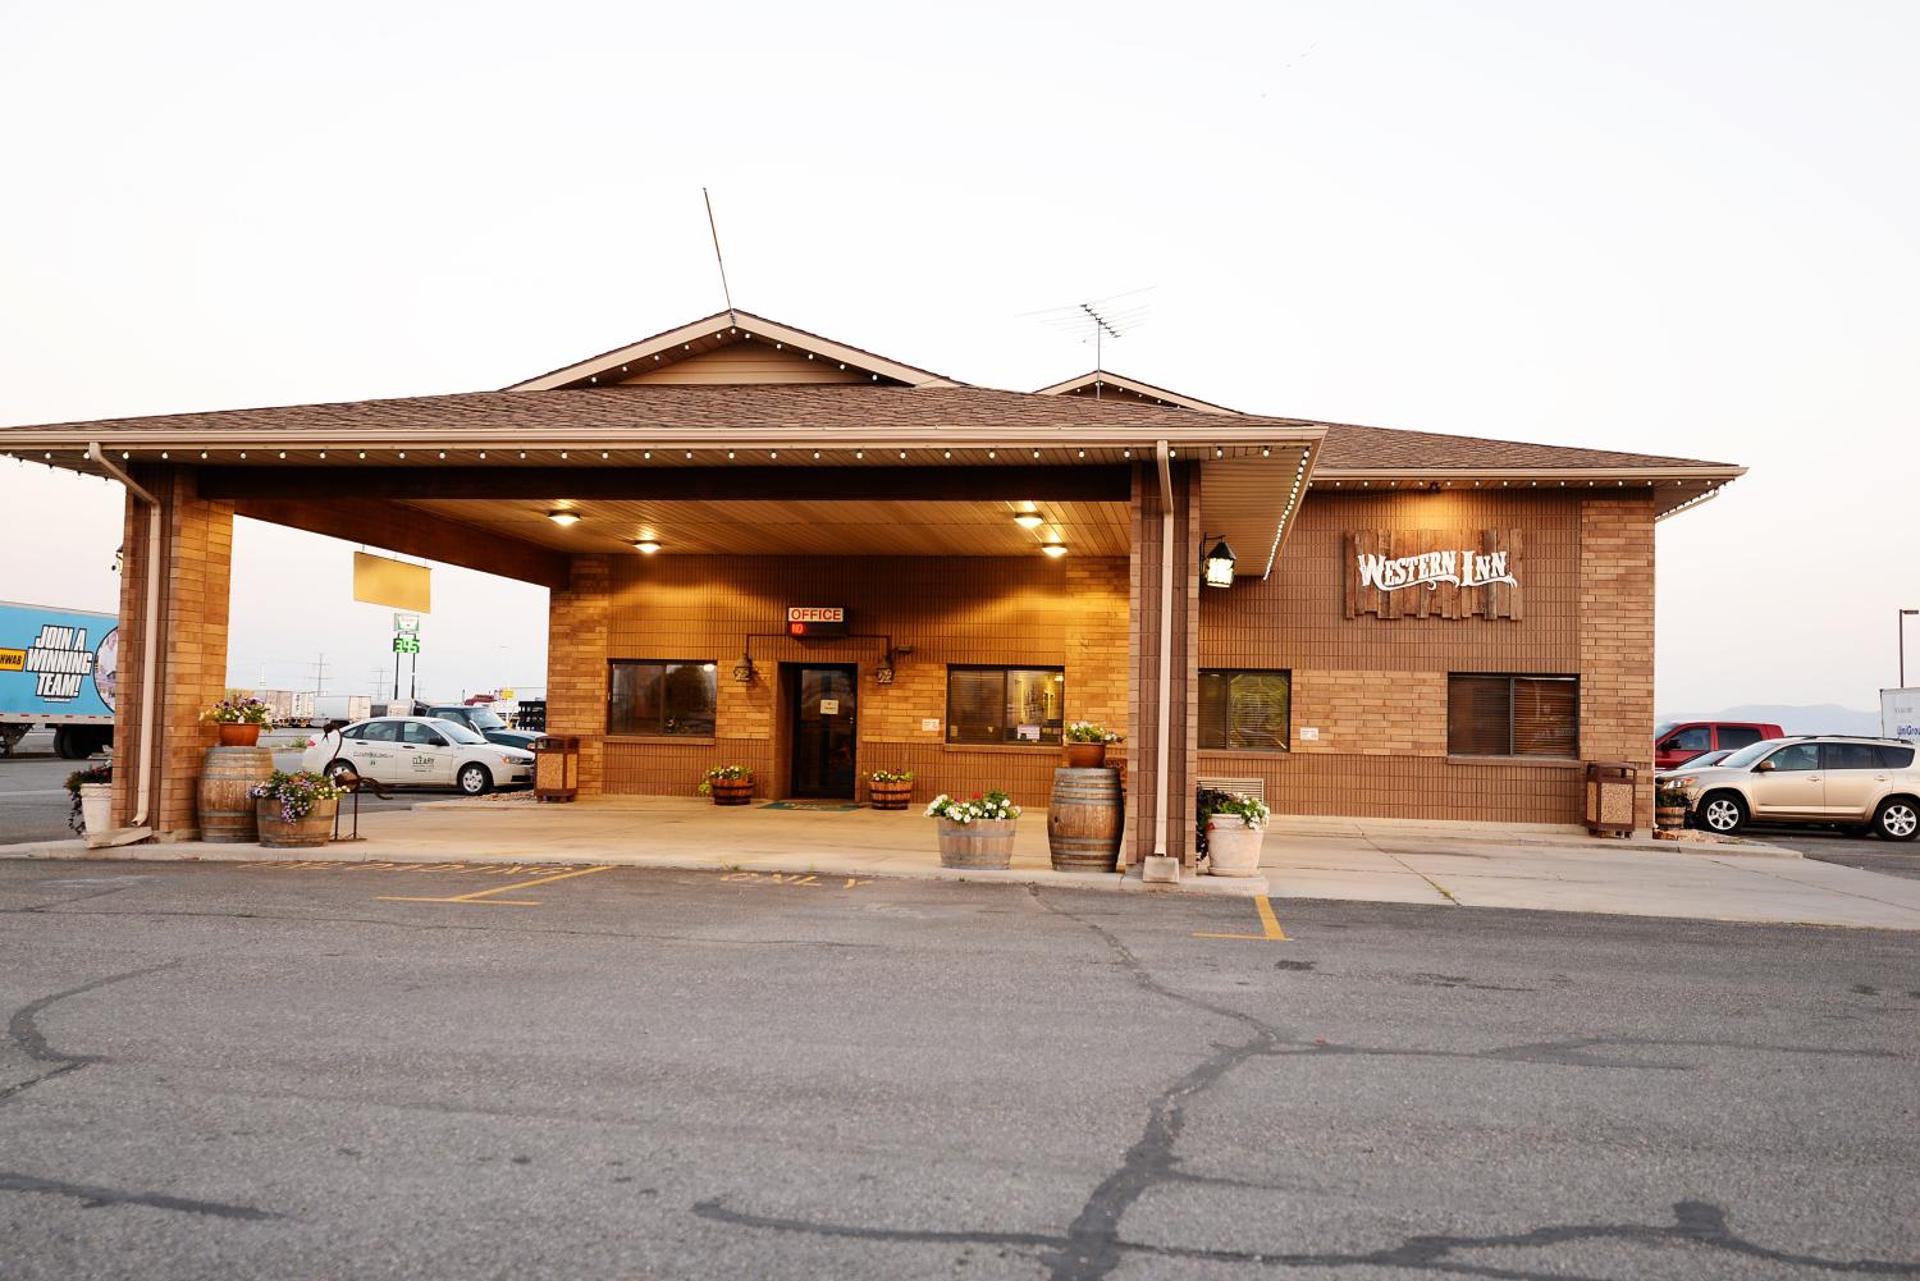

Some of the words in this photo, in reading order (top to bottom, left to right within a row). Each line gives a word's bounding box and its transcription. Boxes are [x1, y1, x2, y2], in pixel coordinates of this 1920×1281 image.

[1357, 551, 1459, 591] WESTERN
[1461, 551, 1517, 588] INN
[791, 608, 842, 620] OFFICE
[35, 626, 74, 650] JOIN
[73, 628, 86, 651] A
[26, 647, 93, 674] WINNING
[36, 672, 83, 697] TEAM!
